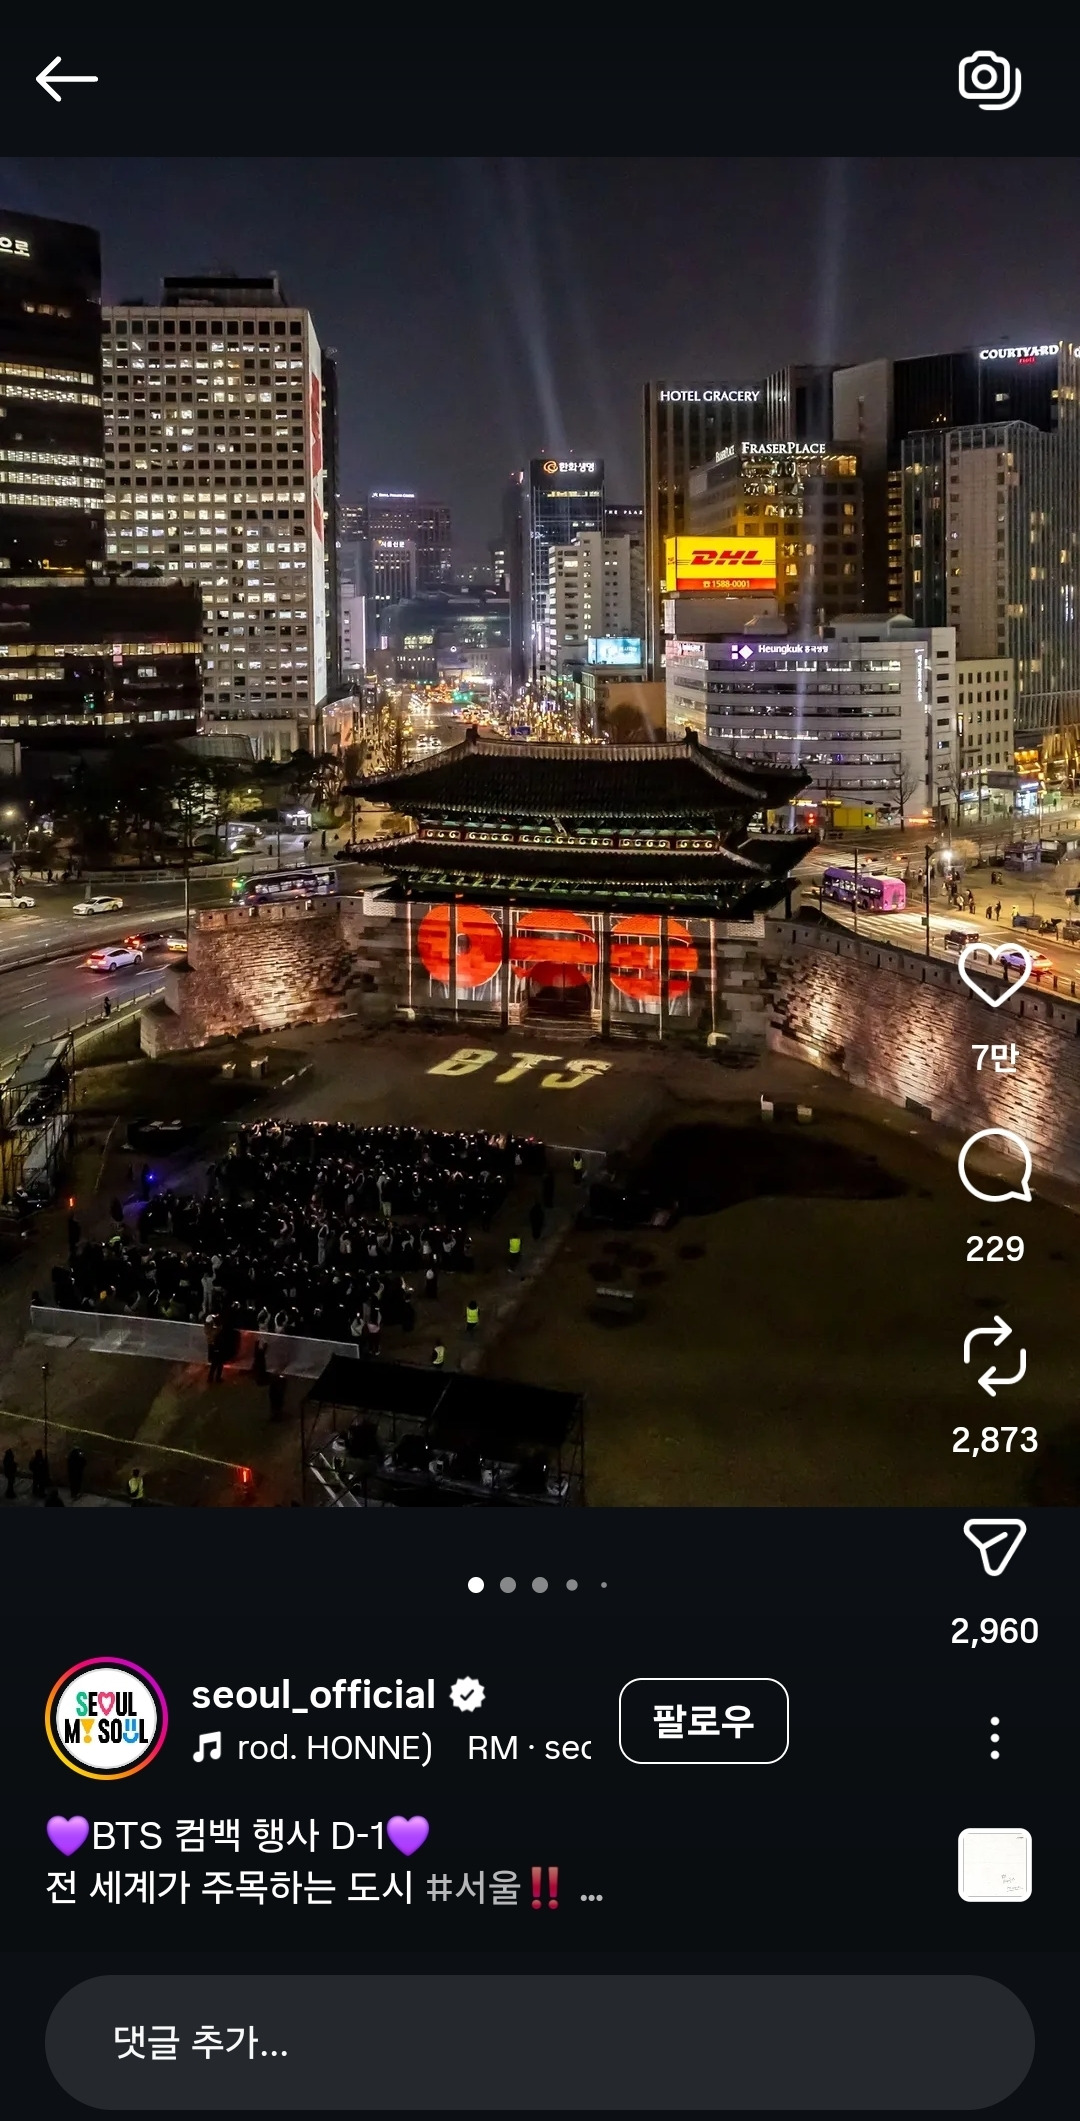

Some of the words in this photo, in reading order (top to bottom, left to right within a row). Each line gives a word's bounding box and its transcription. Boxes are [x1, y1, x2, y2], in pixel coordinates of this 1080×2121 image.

[980, 345, 1059, 360] COURTYARD
[660, 390, 701, 402] HOTEL
[703, 390, 760, 402] GRACERY
[559, 462, 595, 473] 한화생명
[690, 550, 763, 566] DHL
[712, 580, 751, 588] 1588-0001
[758, 644, 804, 655] Heungkuk
[426, 1048, 614, 1090] BTS
